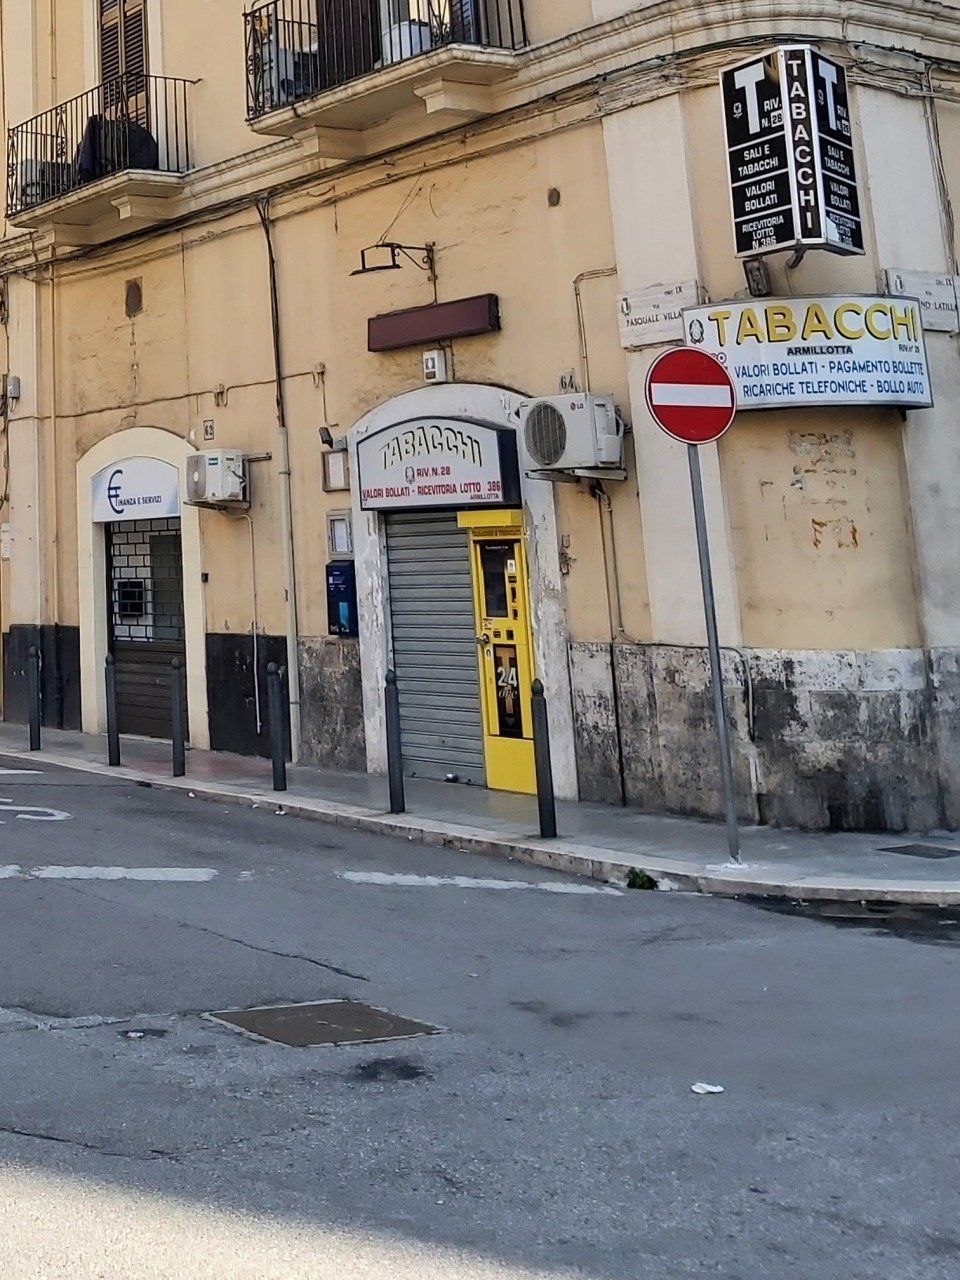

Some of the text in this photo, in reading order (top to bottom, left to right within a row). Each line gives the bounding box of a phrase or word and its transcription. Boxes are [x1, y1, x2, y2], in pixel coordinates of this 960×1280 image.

[734, 62, 765, 134] T
[818, 59, 837, 131] T
[763, 97, 782, 112] RIV.
[761, 113, 782, 128] N. 28
[743, 144, 770, 160] SALI E
[787, 60, 815, 229] TABACCHI
[827, 145, 844, 160] SALI E
[738, 156, 779, 177] TABACCHI
[824, 157, 850, 176] TABACCHI
[745, 180, 775, 197] VALORI
[829, 181, 849, 197] VALORI
[744, 193, 778, 211] BOLLATI
[830, 194, 852, 211] BOLLATI
[742, 214, 784, 233] RICEVITORIA
[752, 227, 774, 240] LOTTO
[626, 310, 682, 327] PASQUALE VILLA
[708, 303, 917, 347] TABACCHI
[787, 345, 853, 357] ARMILLOTTA
[734, 364, 770, 379] VALORI
[773, 362, 818, 377] BOLLATI
[829, 360, 890, 374] PAGAMENTO
[893, 361, 924, 375] BOLLETTE
[560, 375, 574, 389] 64
[743, 382, 796, 397] RICARICHE
[798, 380, 868, 394] TELEFONICHE
[877, 380, 905, 393] BOLLO
[907, 381, 924, 394] AUTO
[378, 425, 482, 470] TABACCHI
[362, 487, 383, 500] VALORI
[385, 486, 410, 498] BOLLATI
[417, 483, 457, 496] RICEVITORIA
[460, 482, 481, 493] LOTTO
[487, 481, 501, 492] 386
[141, 495, 162, 504] SERVIZI
[496, 666, 518, 687] 24
